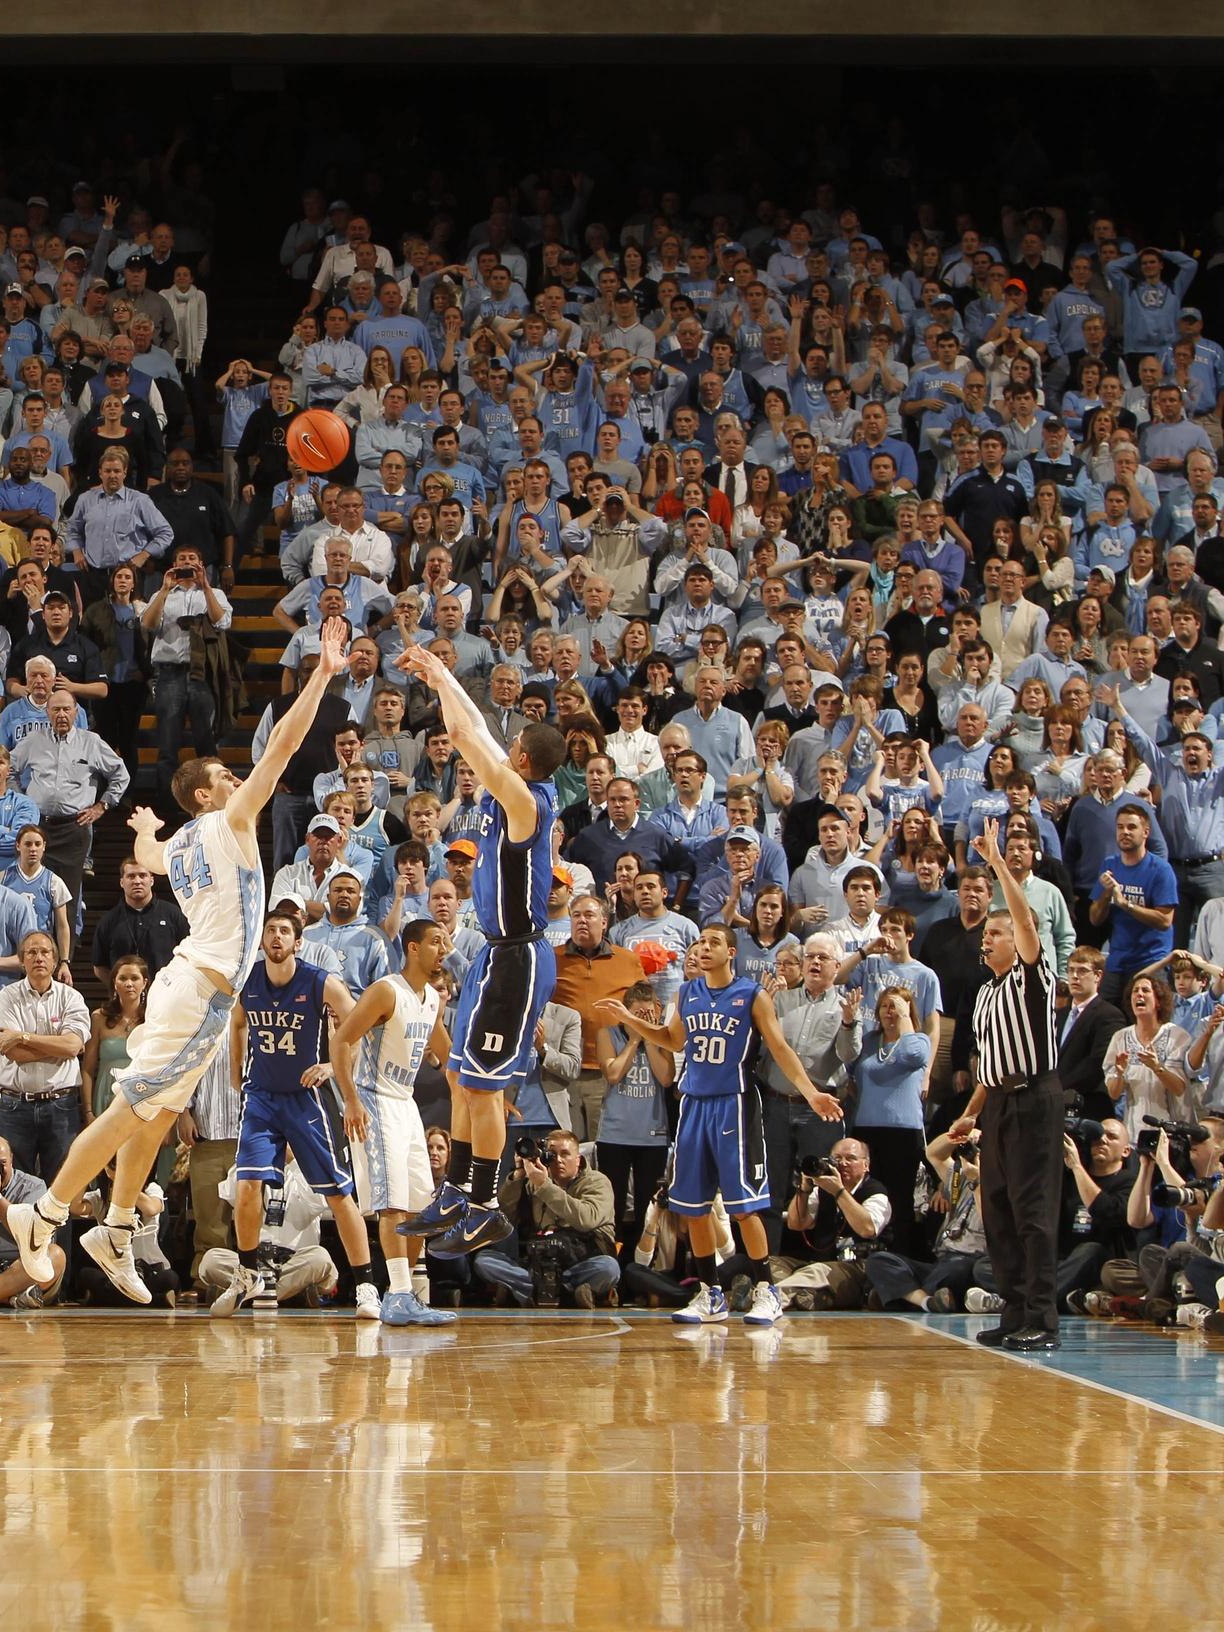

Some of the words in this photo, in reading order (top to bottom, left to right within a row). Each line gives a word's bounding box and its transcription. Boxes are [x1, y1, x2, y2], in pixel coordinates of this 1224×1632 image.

[552, 409, 570, 424] 31
[940, 767, 986, 782] CAROLIN
[350, 833, 375, 848] RTH
[170, 843, 212, 899] 44
[544, 931, 572, 940] OLINA
[247, 1010, 304, 1031] DUKE
[686, 1013, 740, 1036] DUKE
[257, 1031, 296, 1056] 34
[481, 1032, 504, 1053] D
[693, 1035, 726, 1064] 30
[409, 1041, 424, 1068] 5
[385, 1060, 415, 1087] CARO
[625, 1066, 650, 1084] 40
[617, 1083, 656, 1098] CAROLIN
